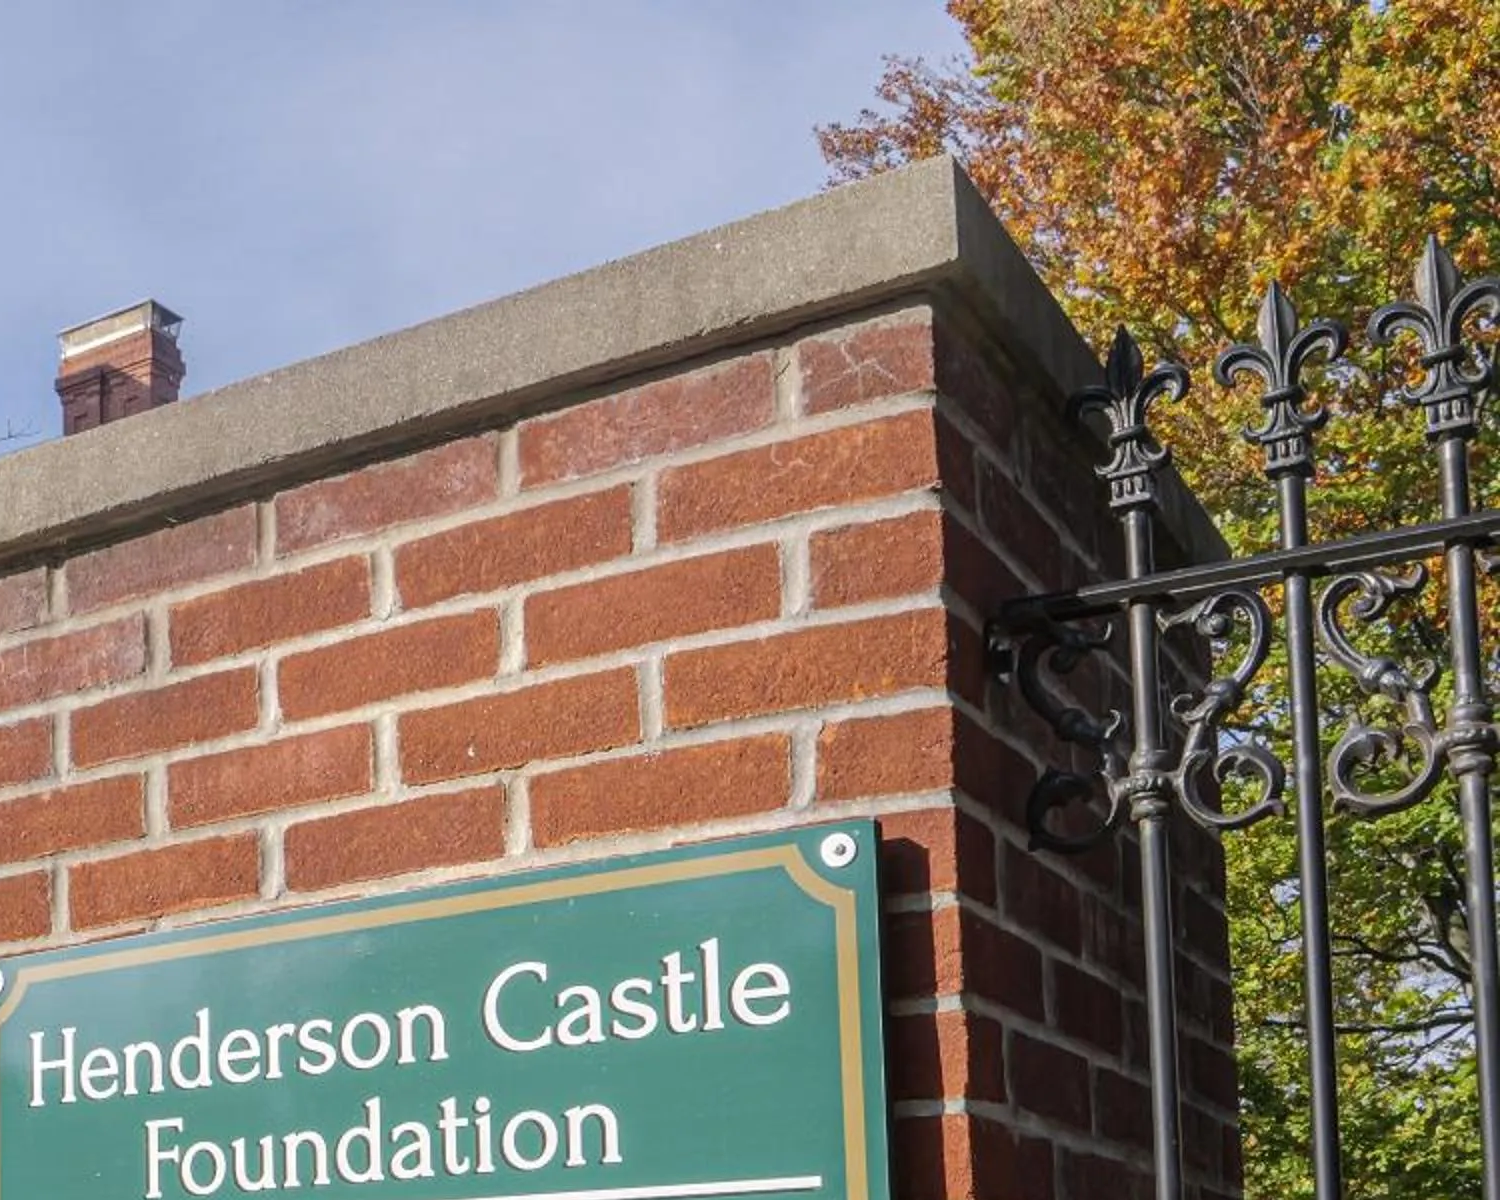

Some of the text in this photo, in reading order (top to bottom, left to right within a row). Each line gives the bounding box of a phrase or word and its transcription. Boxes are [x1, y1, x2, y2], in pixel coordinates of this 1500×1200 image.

[27, 937, 792, 1108] Henderson Castle
[145, 1096, 623, 1199] Foundation
